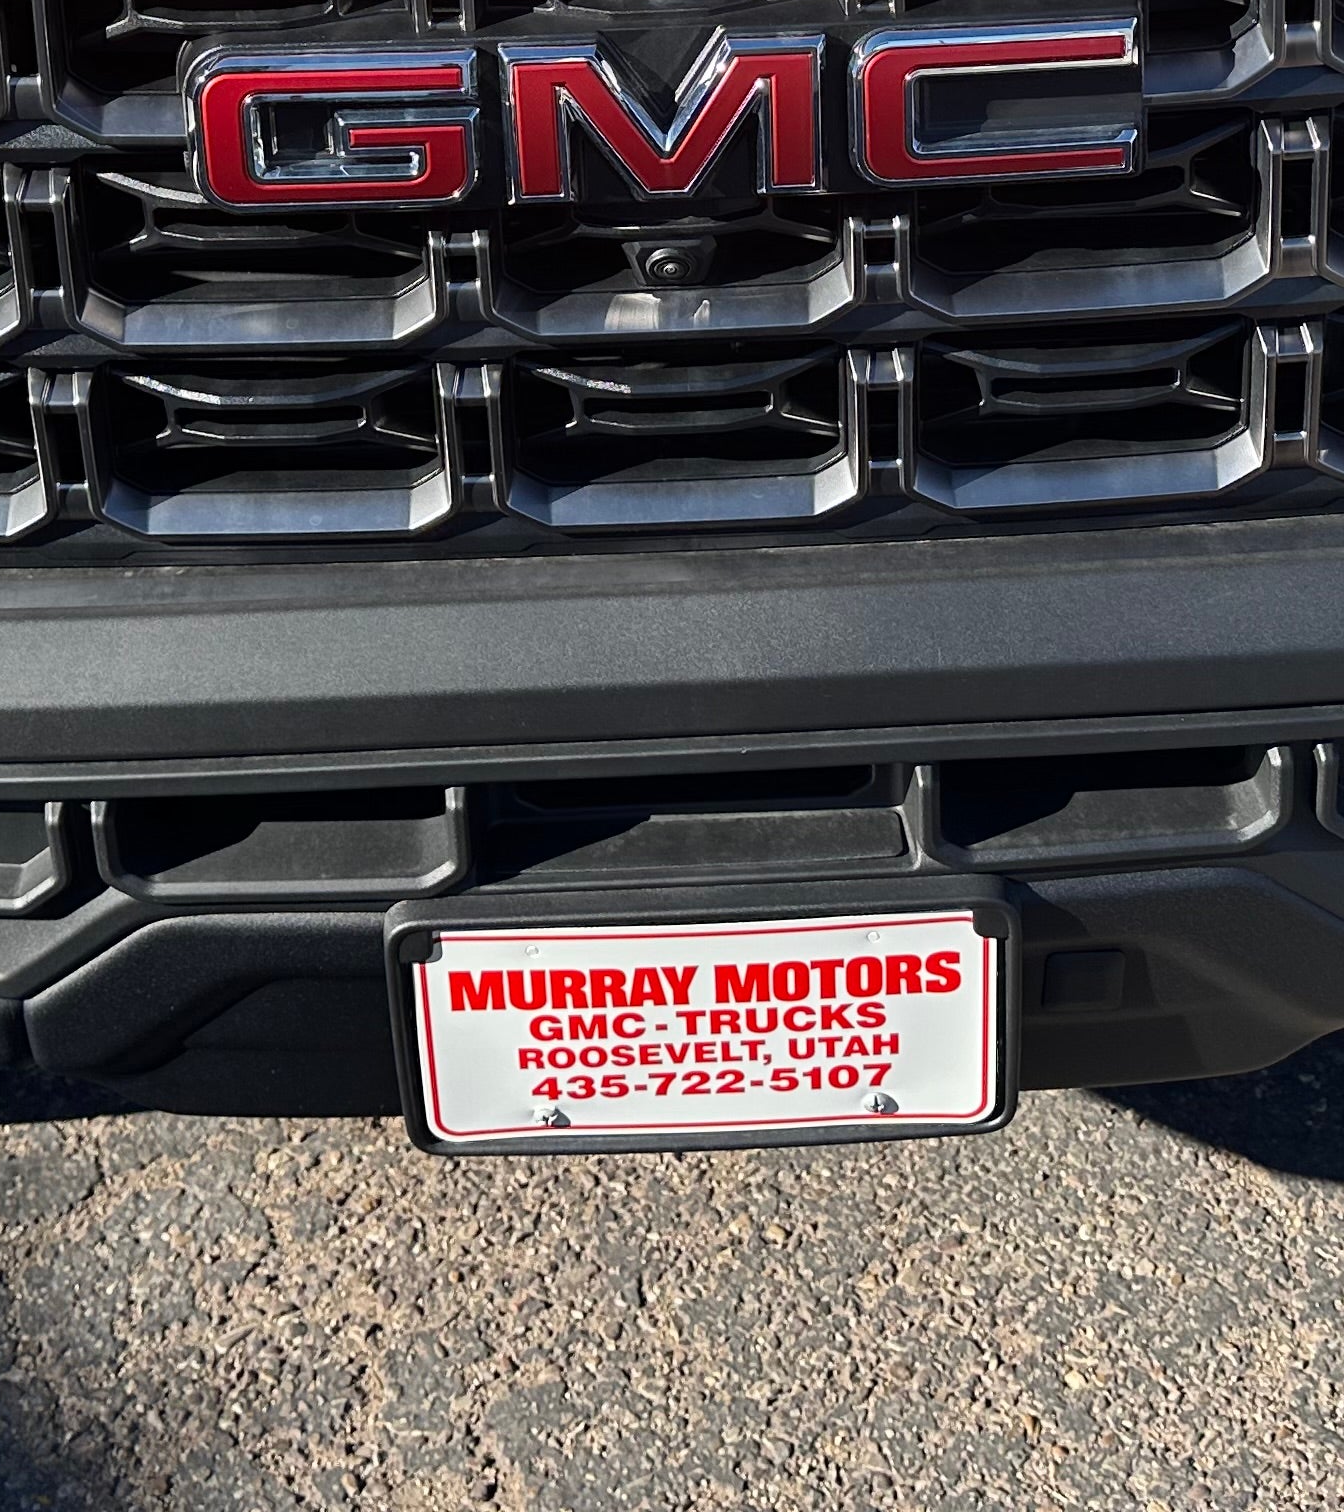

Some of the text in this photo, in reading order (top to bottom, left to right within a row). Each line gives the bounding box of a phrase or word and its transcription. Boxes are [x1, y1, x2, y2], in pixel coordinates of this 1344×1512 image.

[184, 18, 1141, 209] GMC
[448, 950, 962, 1012] MURRAY MOTORS
[529, 1013, 647, 1042] GMC
[676, 1001, 887, 1035] TRUCKS
[518, 1033, 900, 1070] ROOSEVELT, UTAH
[531, 1063, 893, 1101] 435-722-5107
